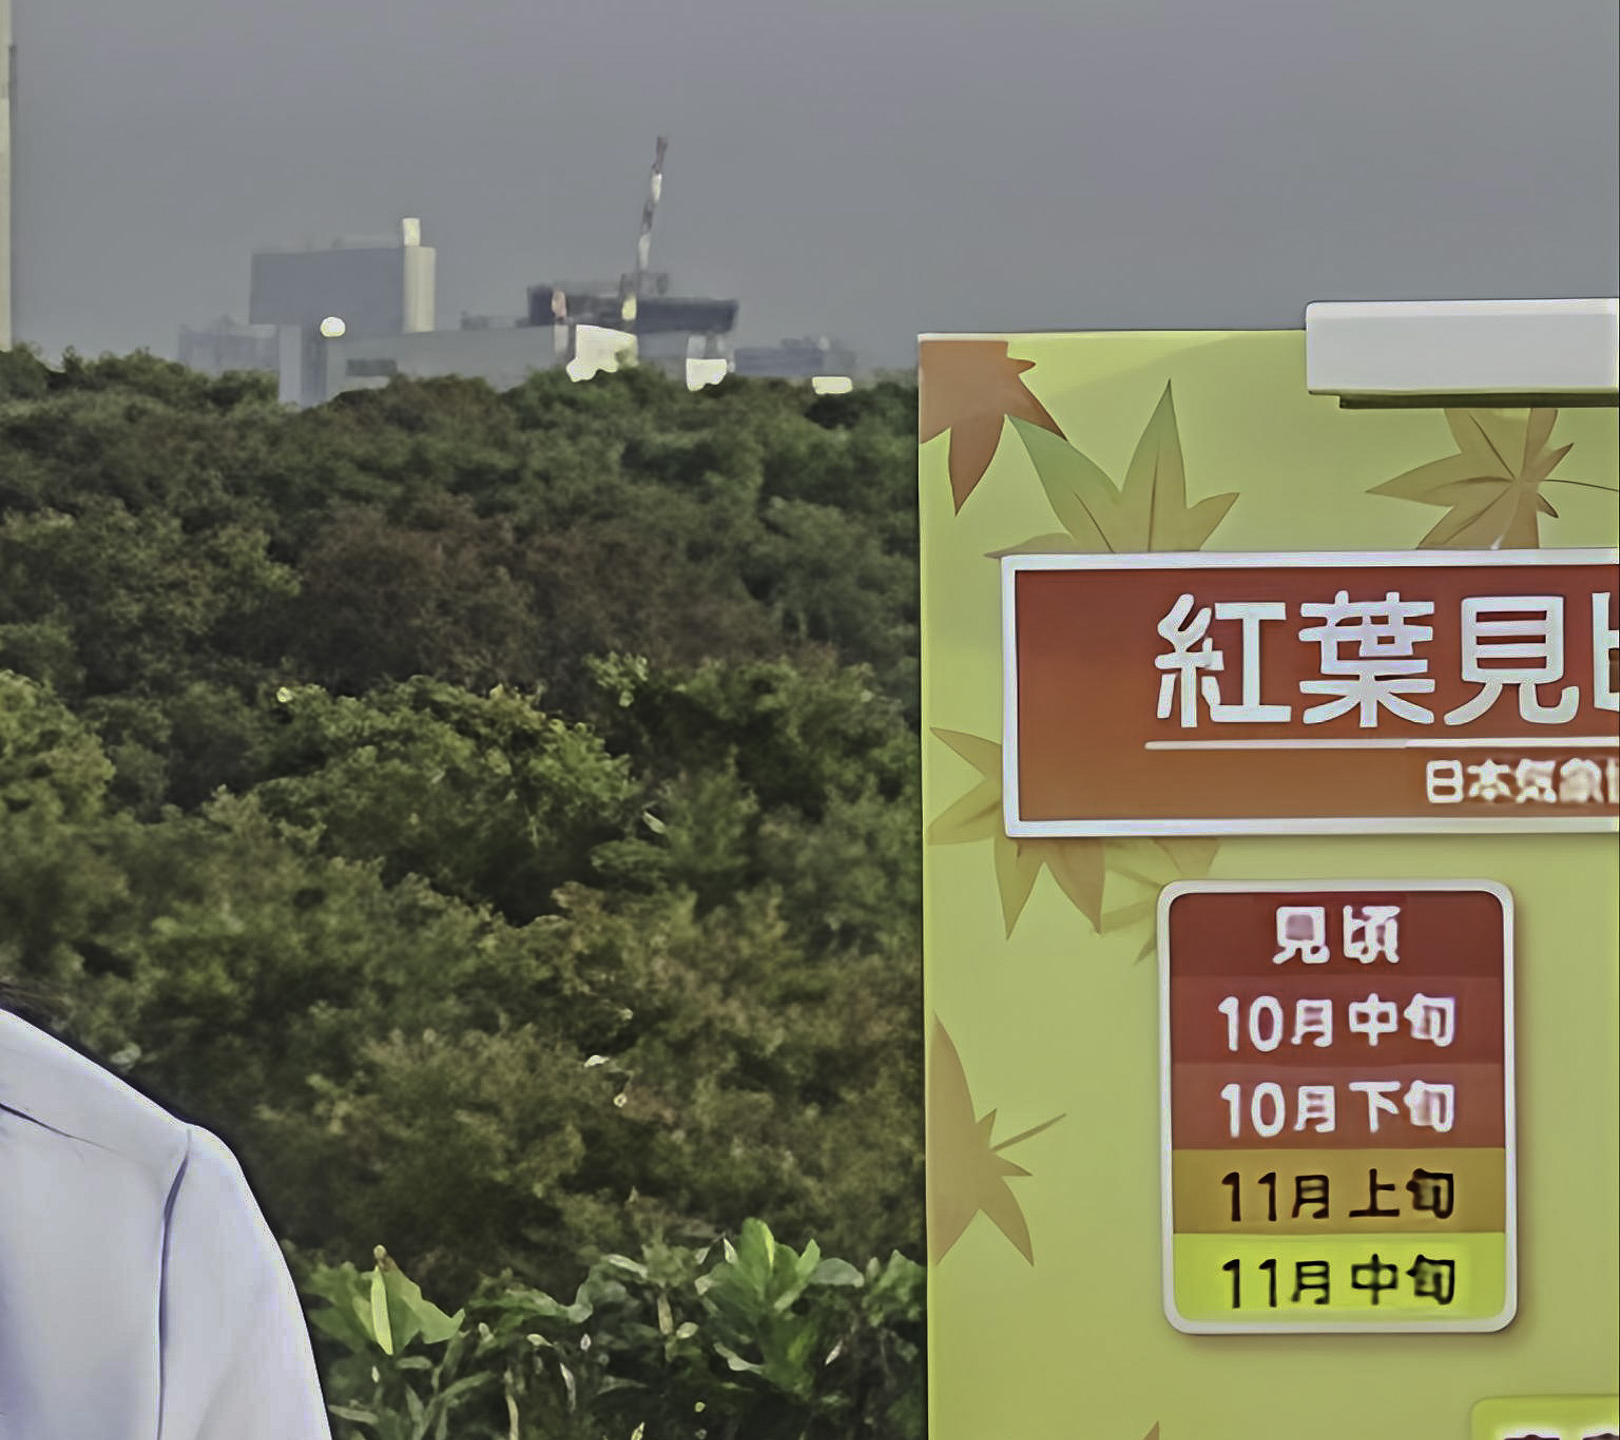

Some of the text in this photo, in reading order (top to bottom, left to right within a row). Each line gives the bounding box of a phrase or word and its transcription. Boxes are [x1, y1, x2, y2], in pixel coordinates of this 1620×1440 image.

[1155, 590, 1619, 728] 紅葉見
[1426, 758, 1619, 803] 日本気象
[1272, 905, 1400, 965] 見頃
[1218, 992, 1456, 1052] 10月中旬
[1220, 1080, 1456, 1139] 10月下旬
[1221, 1167, 1455, 1222] 11月上旬
[1222, 1253, 1456, 1309] 11月中旬
